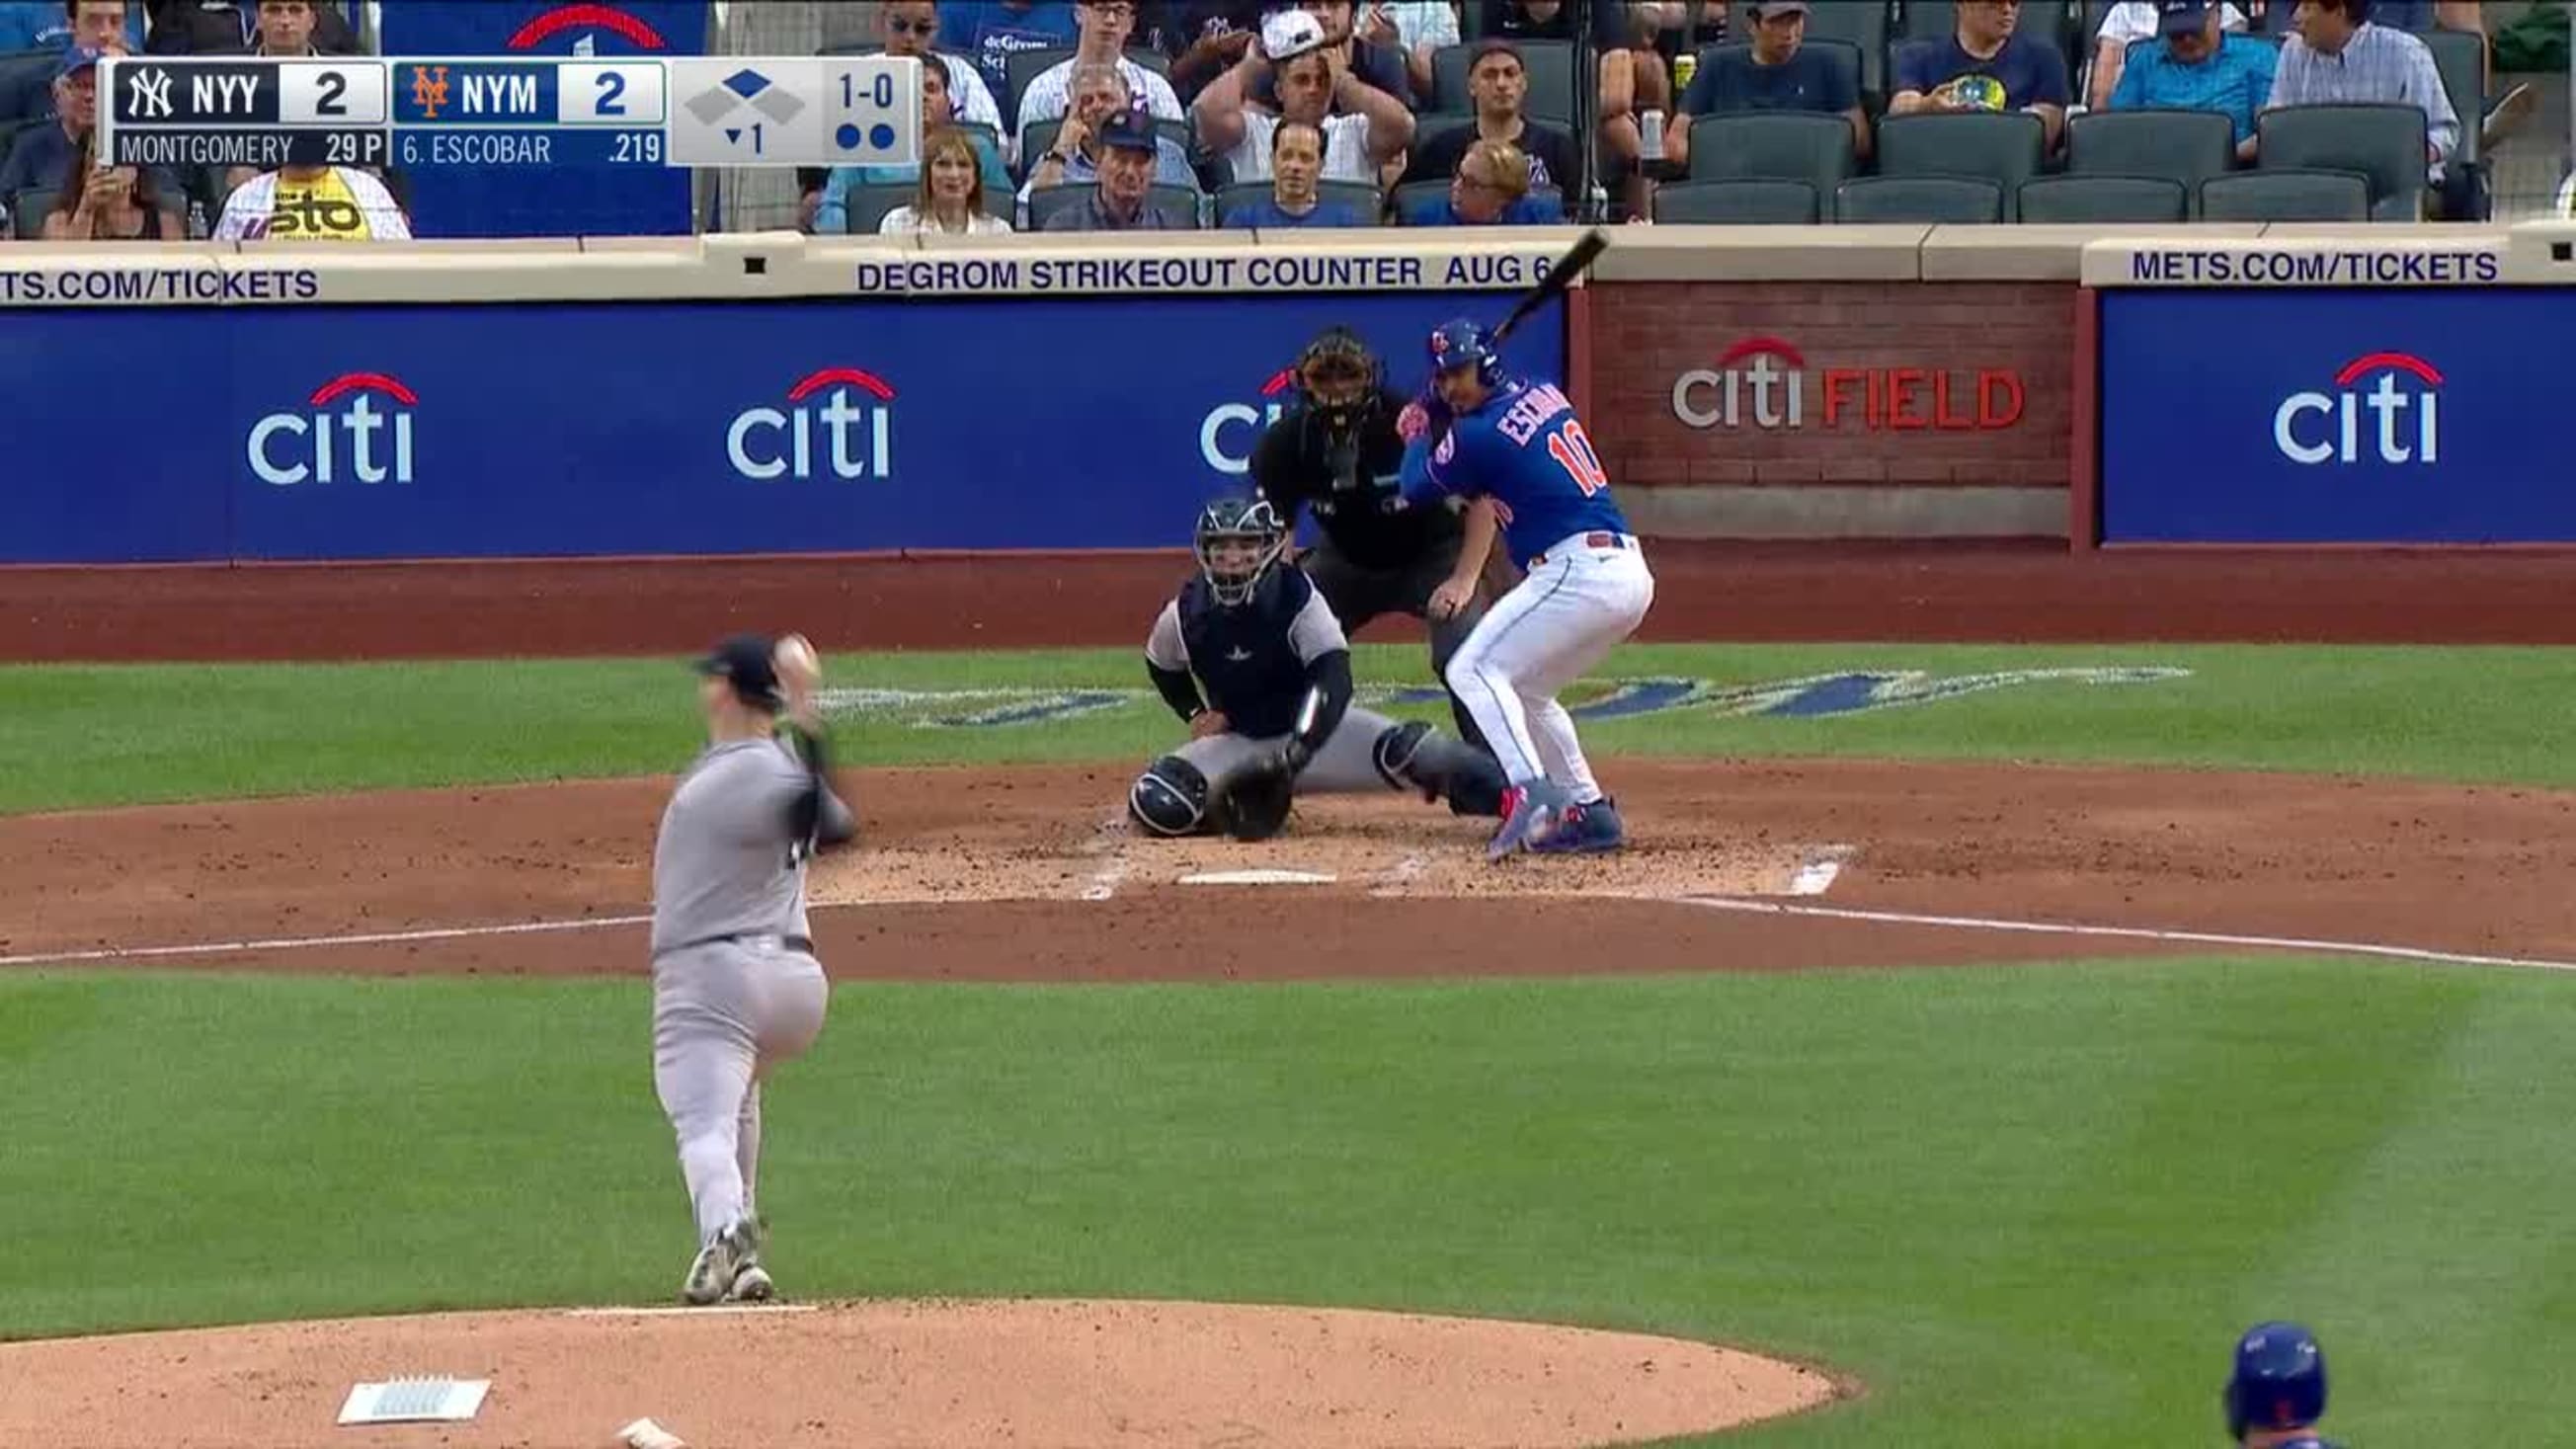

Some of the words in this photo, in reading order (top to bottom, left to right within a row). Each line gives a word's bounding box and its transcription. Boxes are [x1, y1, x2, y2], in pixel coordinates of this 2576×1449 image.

[858, 262, 1017, 290] DEGROM
[1030, 259, 1237, 288] STRIKEOUT
[1248, 258, 1420, 286] COUNTER
[1445, 256, 1521, 284] AUG
[2133, 252, 2497, 281] METS.COM/TICKETS
[1673, 353, 1802, 428] citi
[1823, 369, 2023, 427] FIELD
[2274, 371, 2437, 464] citi
[248, 392, 413, 485] citi
[727, 386, 890, 479] citi
[1548, 419, 1607, 498] 10
